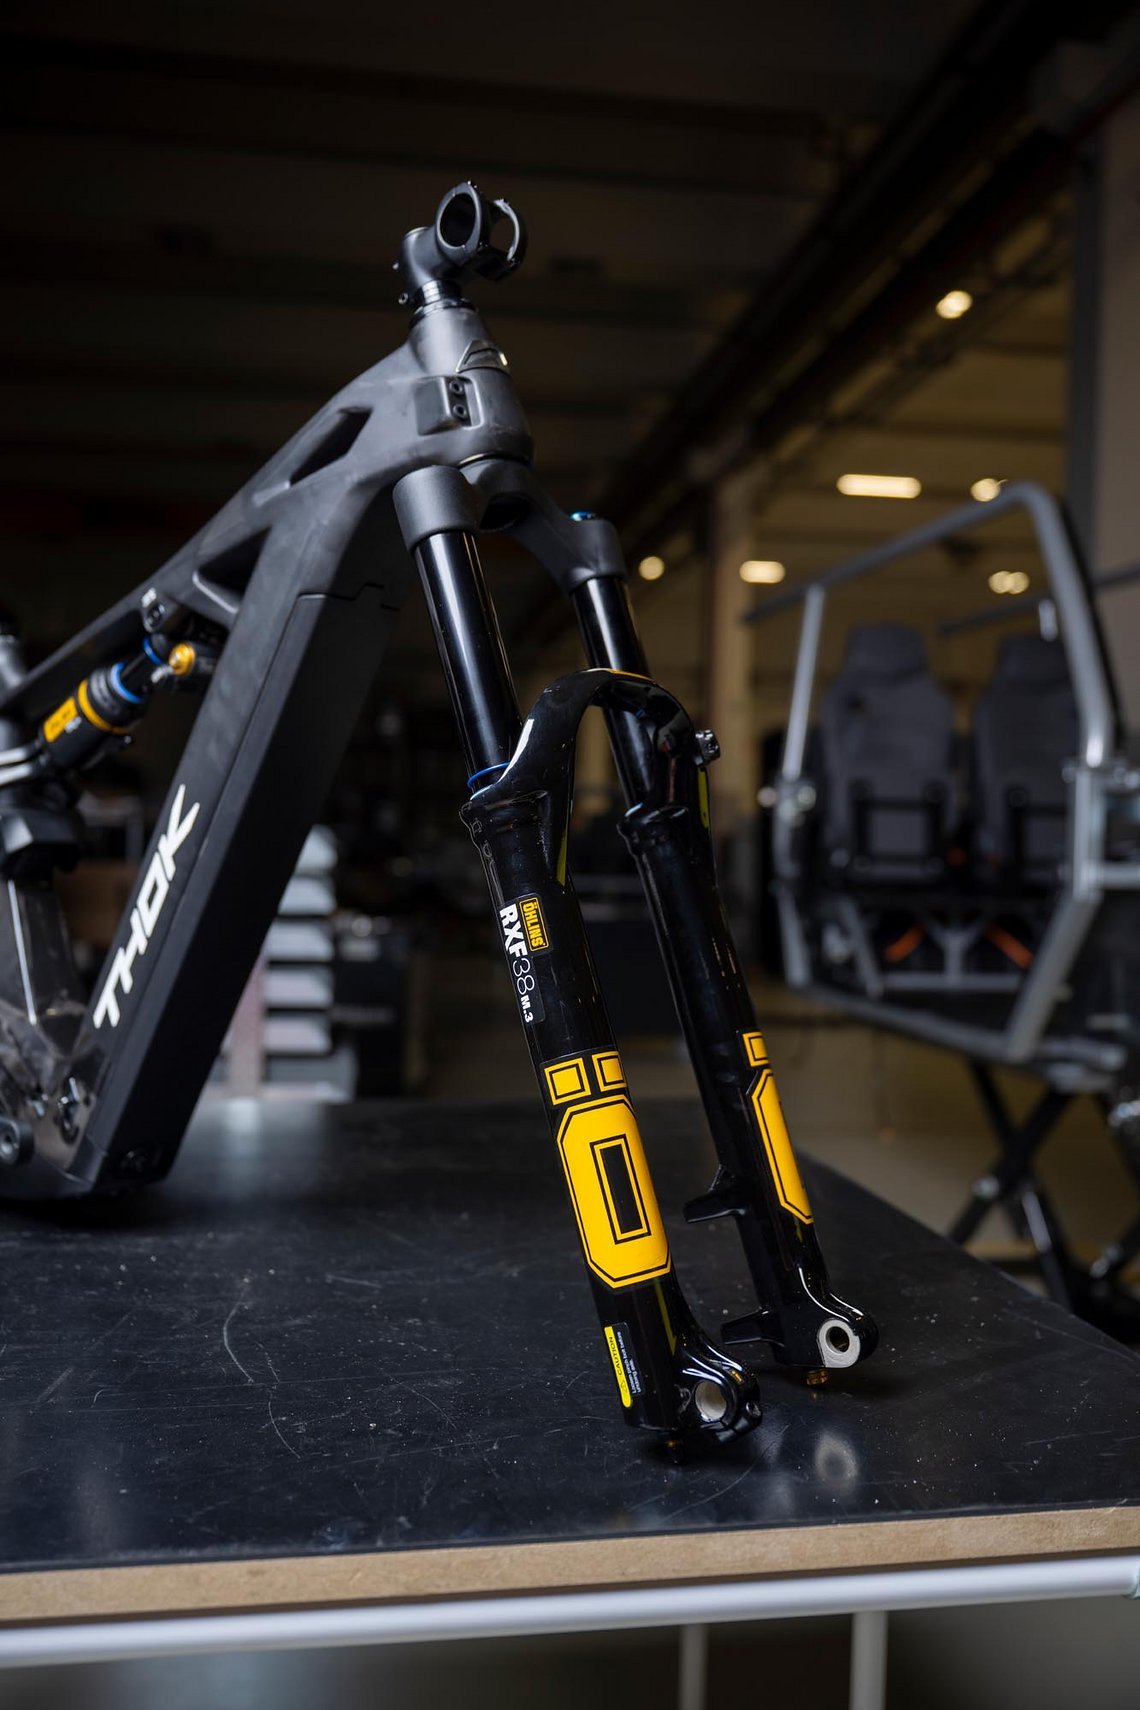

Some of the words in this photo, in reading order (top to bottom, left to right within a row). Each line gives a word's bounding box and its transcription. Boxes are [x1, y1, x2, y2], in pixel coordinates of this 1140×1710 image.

[93, 784, 200, 1028] THOK
[522, 901, 546, 948] ÖHLINS
[609, 1336, 622, 1376] CAUTION
